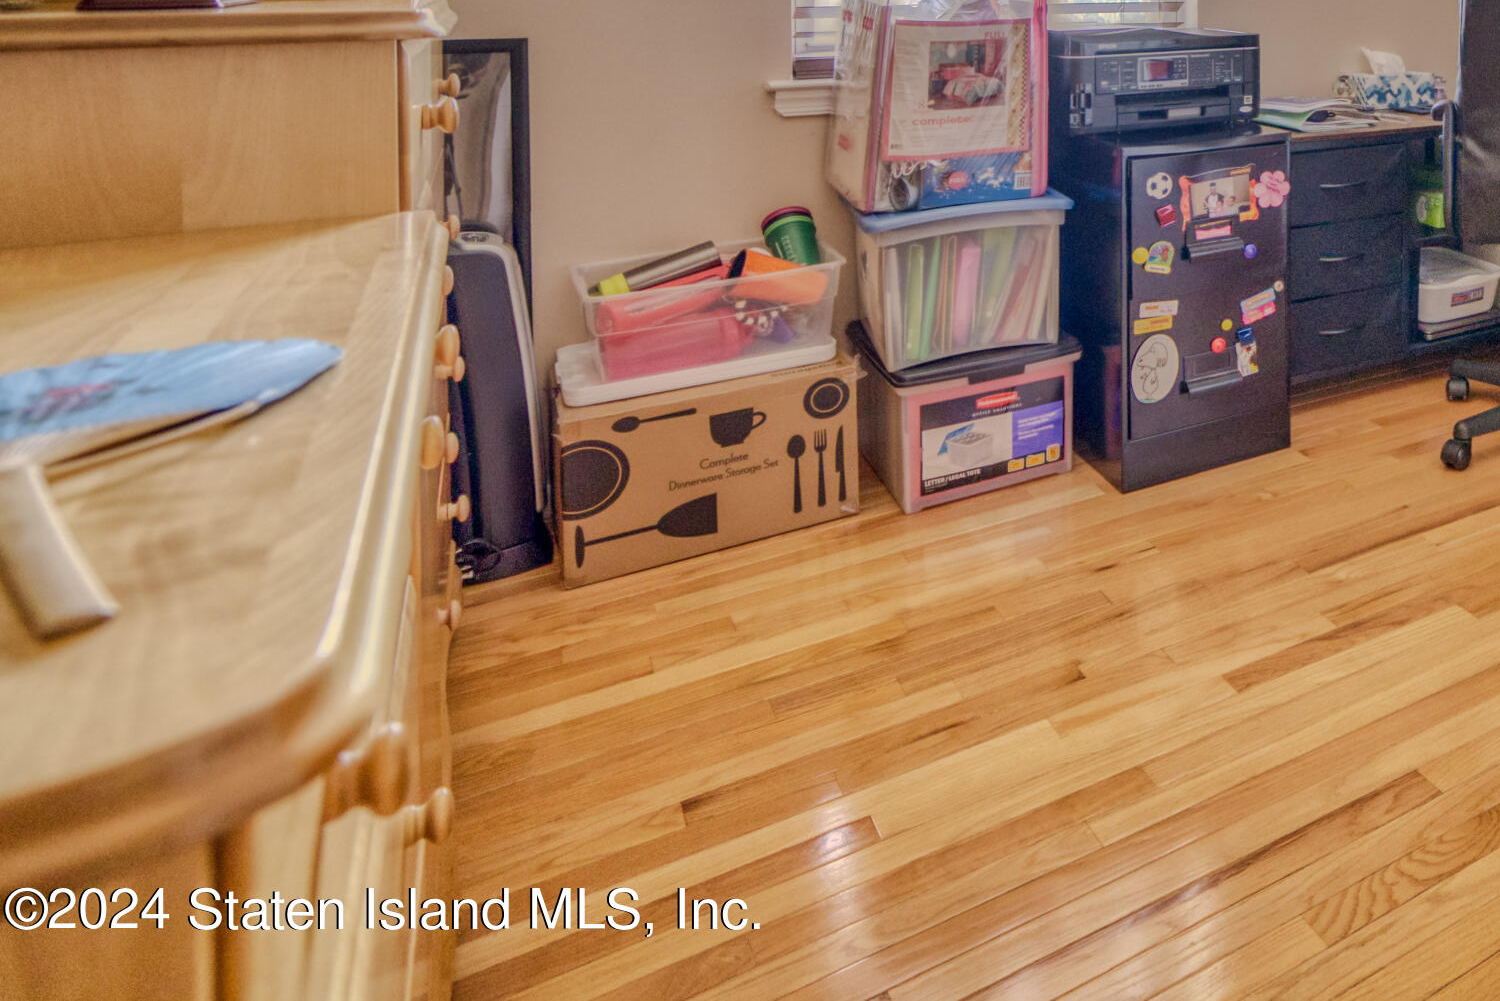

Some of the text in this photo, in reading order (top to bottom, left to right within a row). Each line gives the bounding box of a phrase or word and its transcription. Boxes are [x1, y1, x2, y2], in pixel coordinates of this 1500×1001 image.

[699, 452, 749, 470] Complete
[669, 458, 779, 491] Dinnerware Storage Set
[967, 468, 982, 477] TOTE
